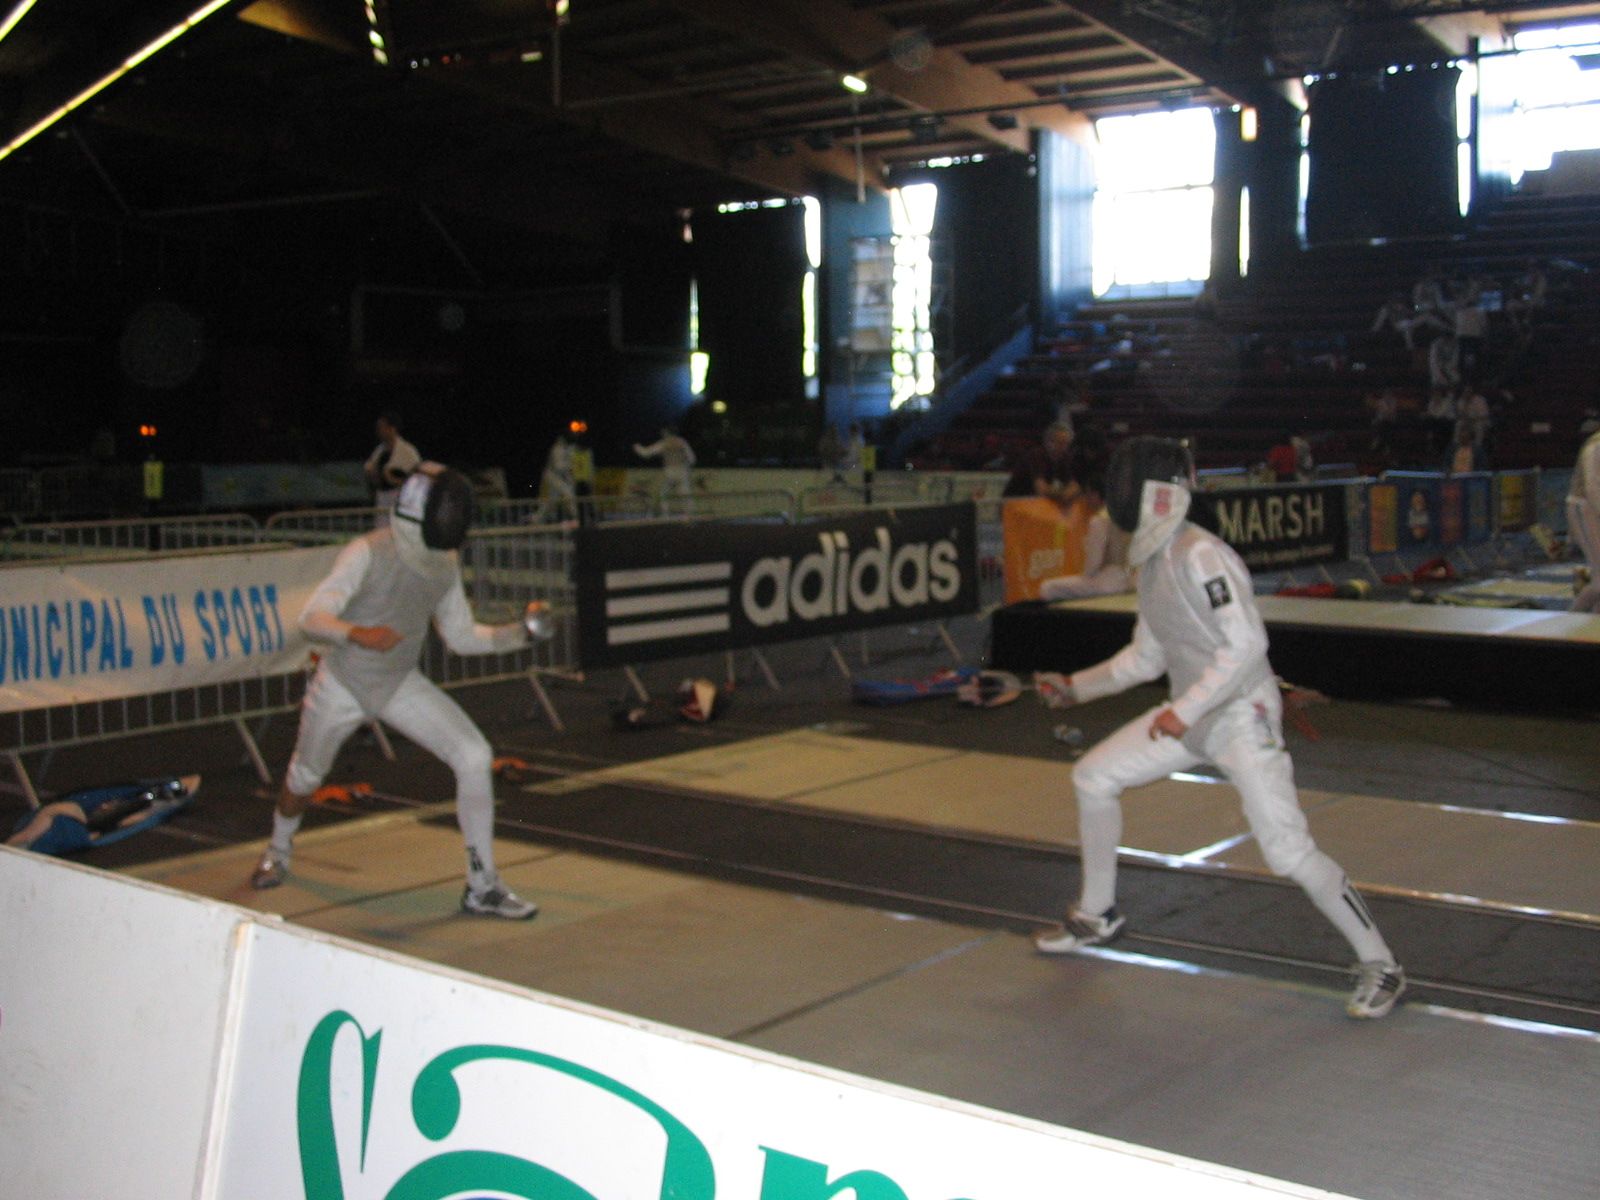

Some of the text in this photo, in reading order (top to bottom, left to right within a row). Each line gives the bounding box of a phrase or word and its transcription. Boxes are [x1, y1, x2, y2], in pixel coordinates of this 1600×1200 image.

[1216, 492, 1324, 543] MARSH
[741, 526, 961, 627] adidas
[142, 593, 185, 666] DU
[194, 583, 285, 662] SPORT
